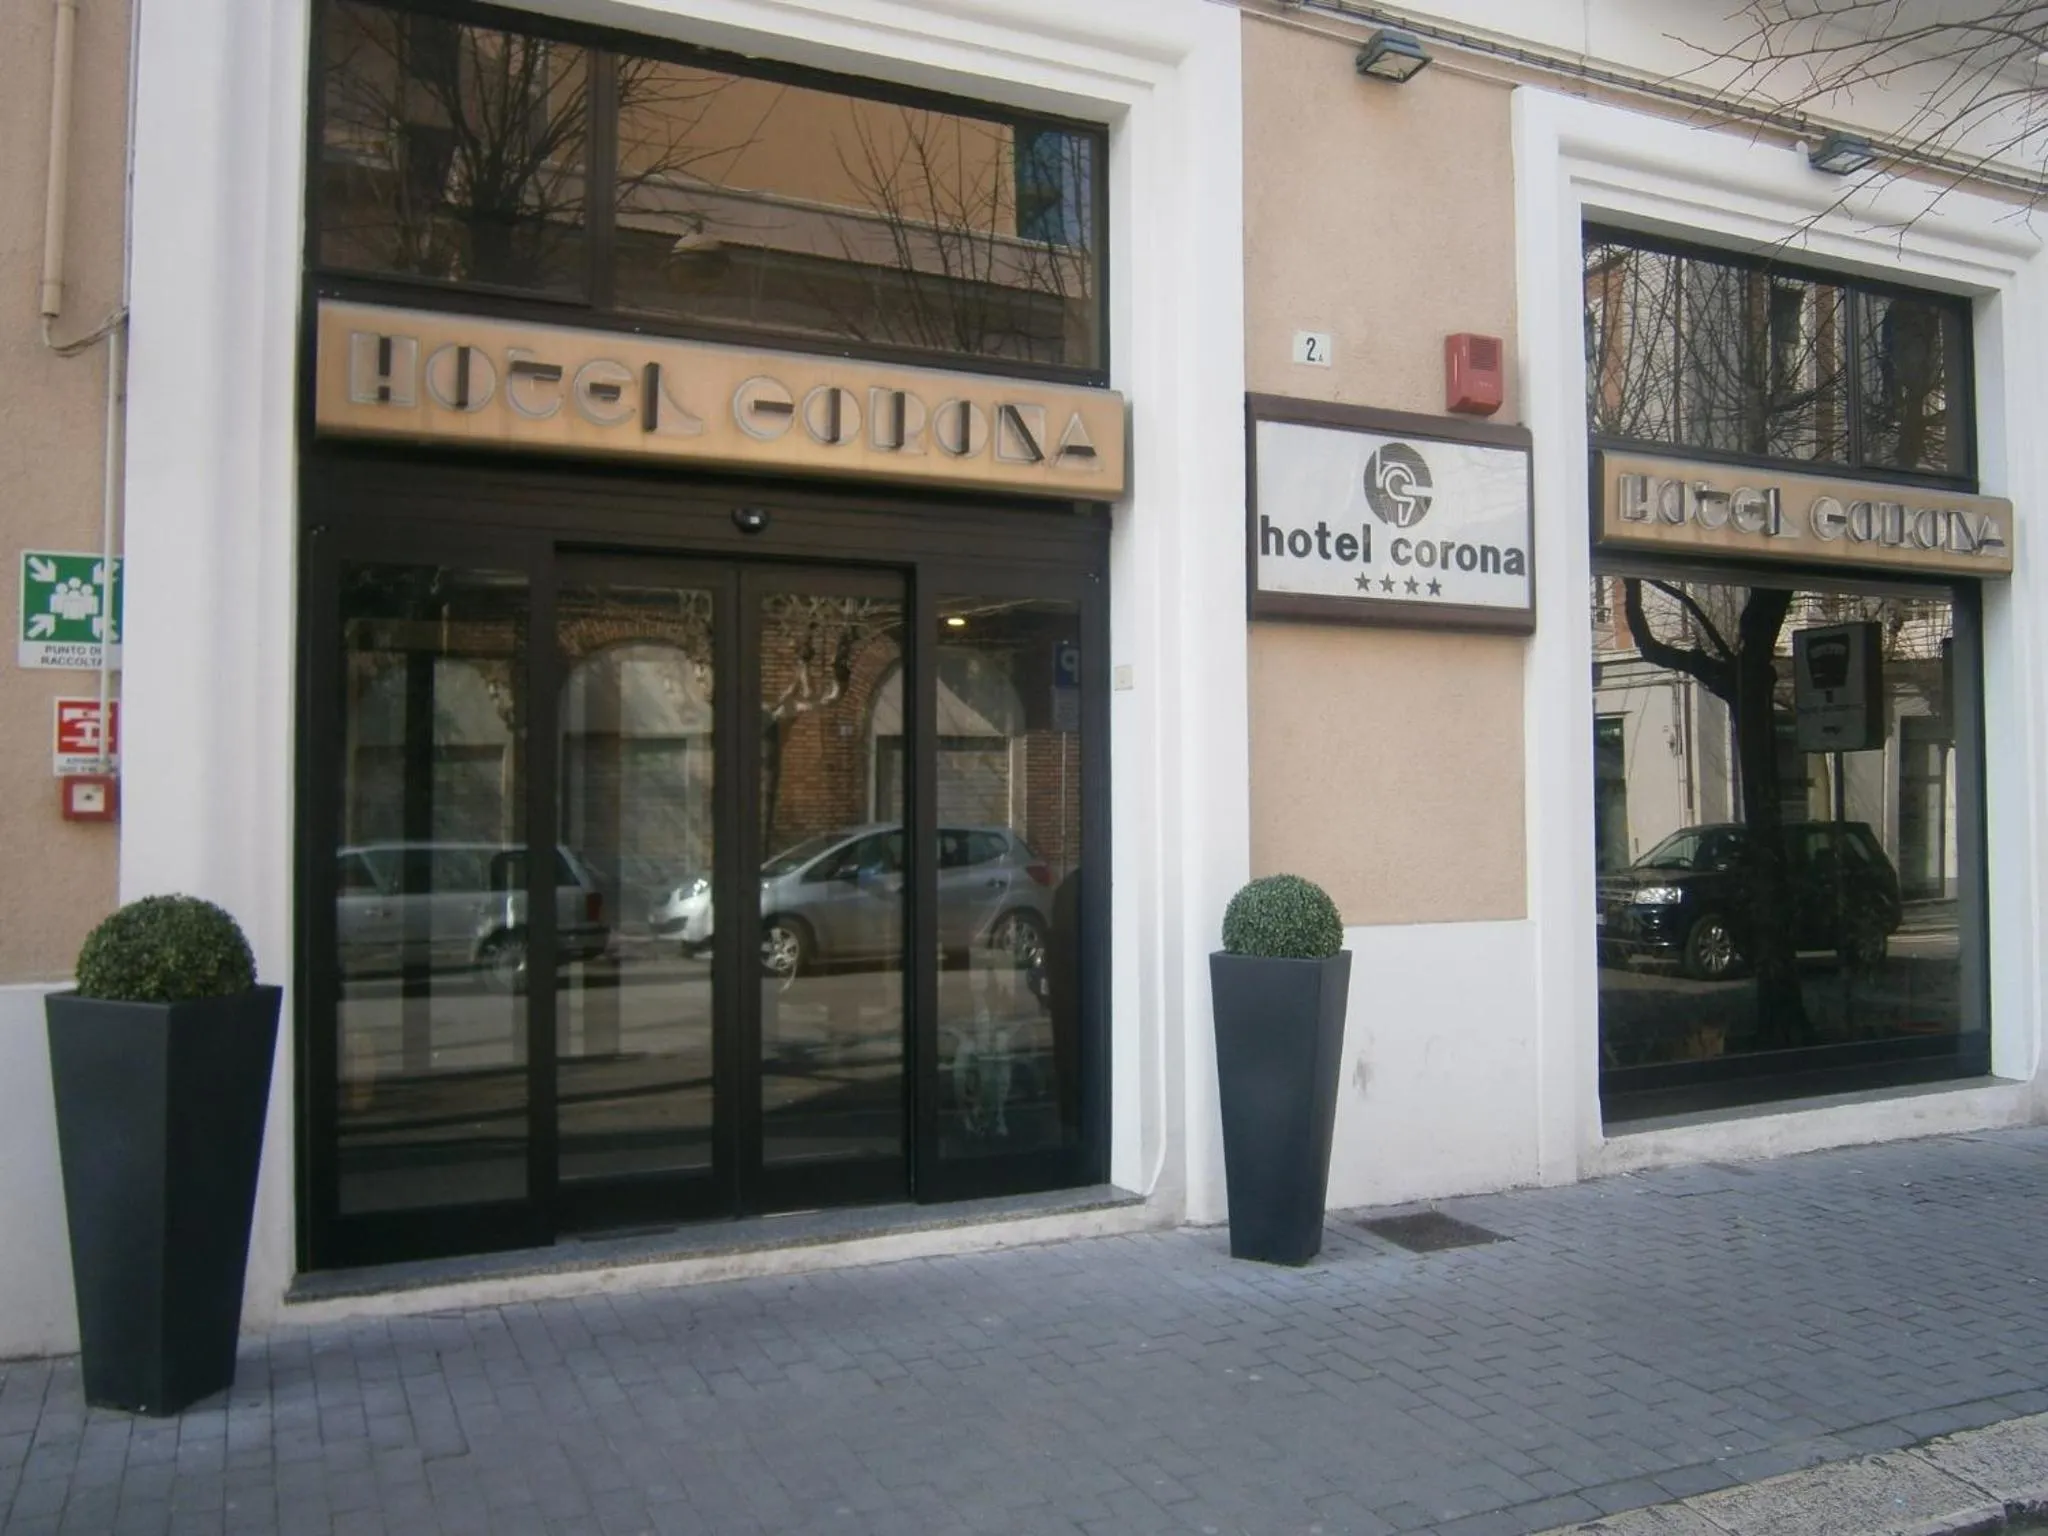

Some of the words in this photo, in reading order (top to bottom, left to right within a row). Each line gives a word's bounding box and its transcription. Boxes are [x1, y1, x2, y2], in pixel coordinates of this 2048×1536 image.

[349, 332, 704, 437] HOTEL
[733, 375, 1103, 472] CORONA
[1260, 515, 1372, 564] hotel
[1390, 537, 1526, 576] corona
[1618, 473, 1801, 539] HOTEL
[1808, 496, 2006, 555] CORONA
[44, 644, 86, 655] PUNTO
